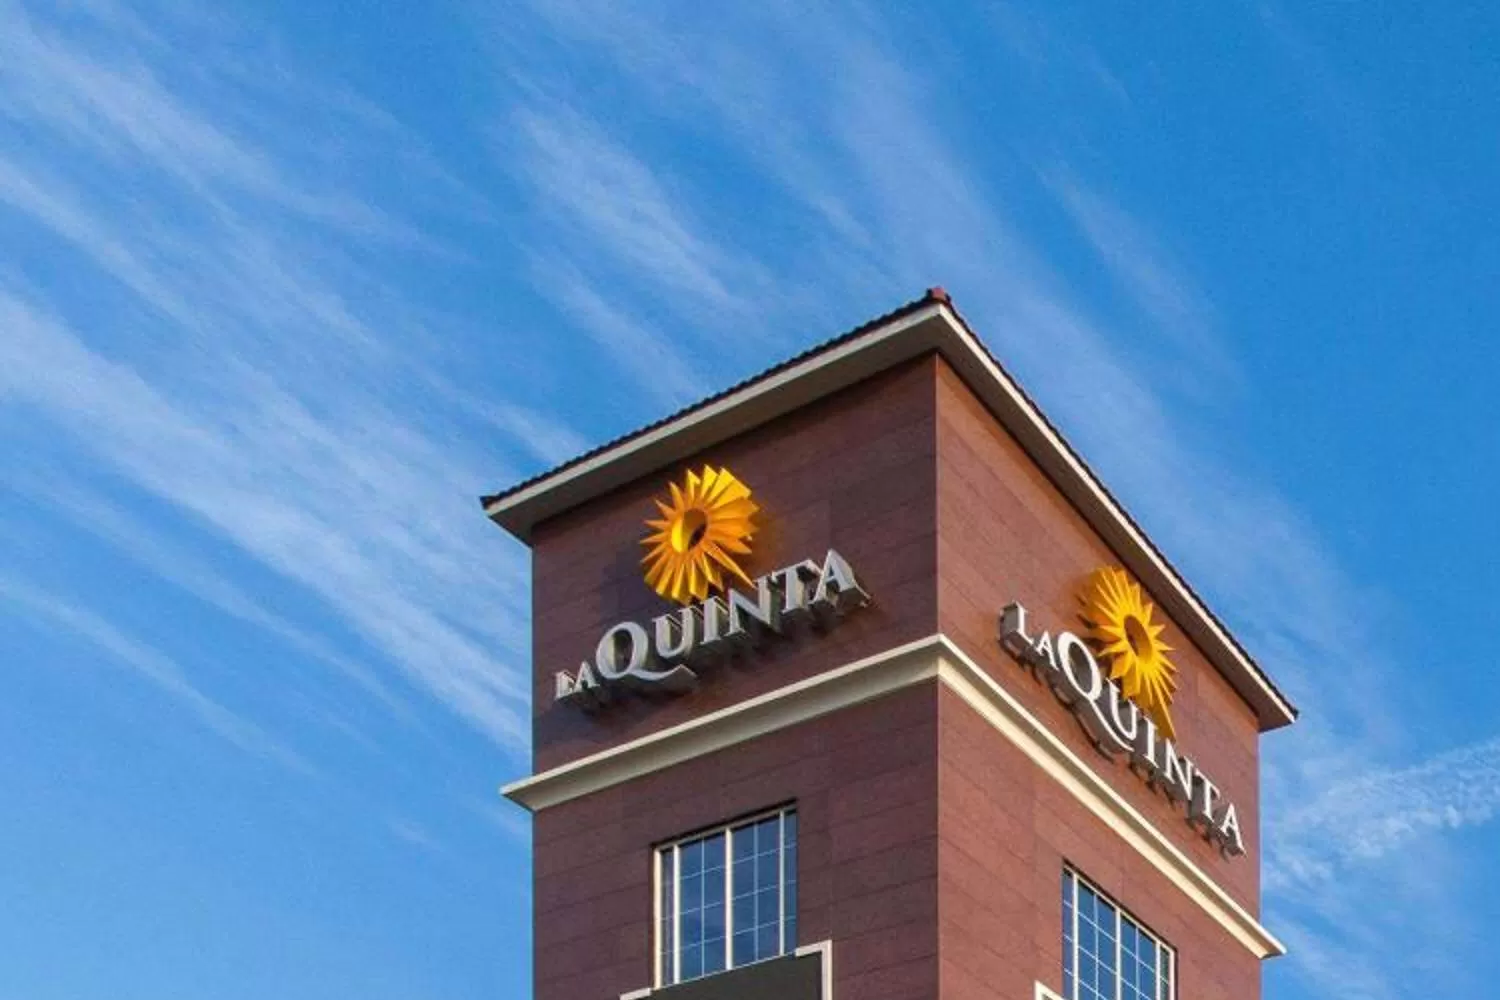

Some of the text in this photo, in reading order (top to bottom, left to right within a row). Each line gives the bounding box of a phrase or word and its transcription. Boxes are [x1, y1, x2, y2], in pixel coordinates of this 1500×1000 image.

[554, 548, 873, 700] LA QUINTA
[1006, 600, 1247, 857] LA QUINTA
